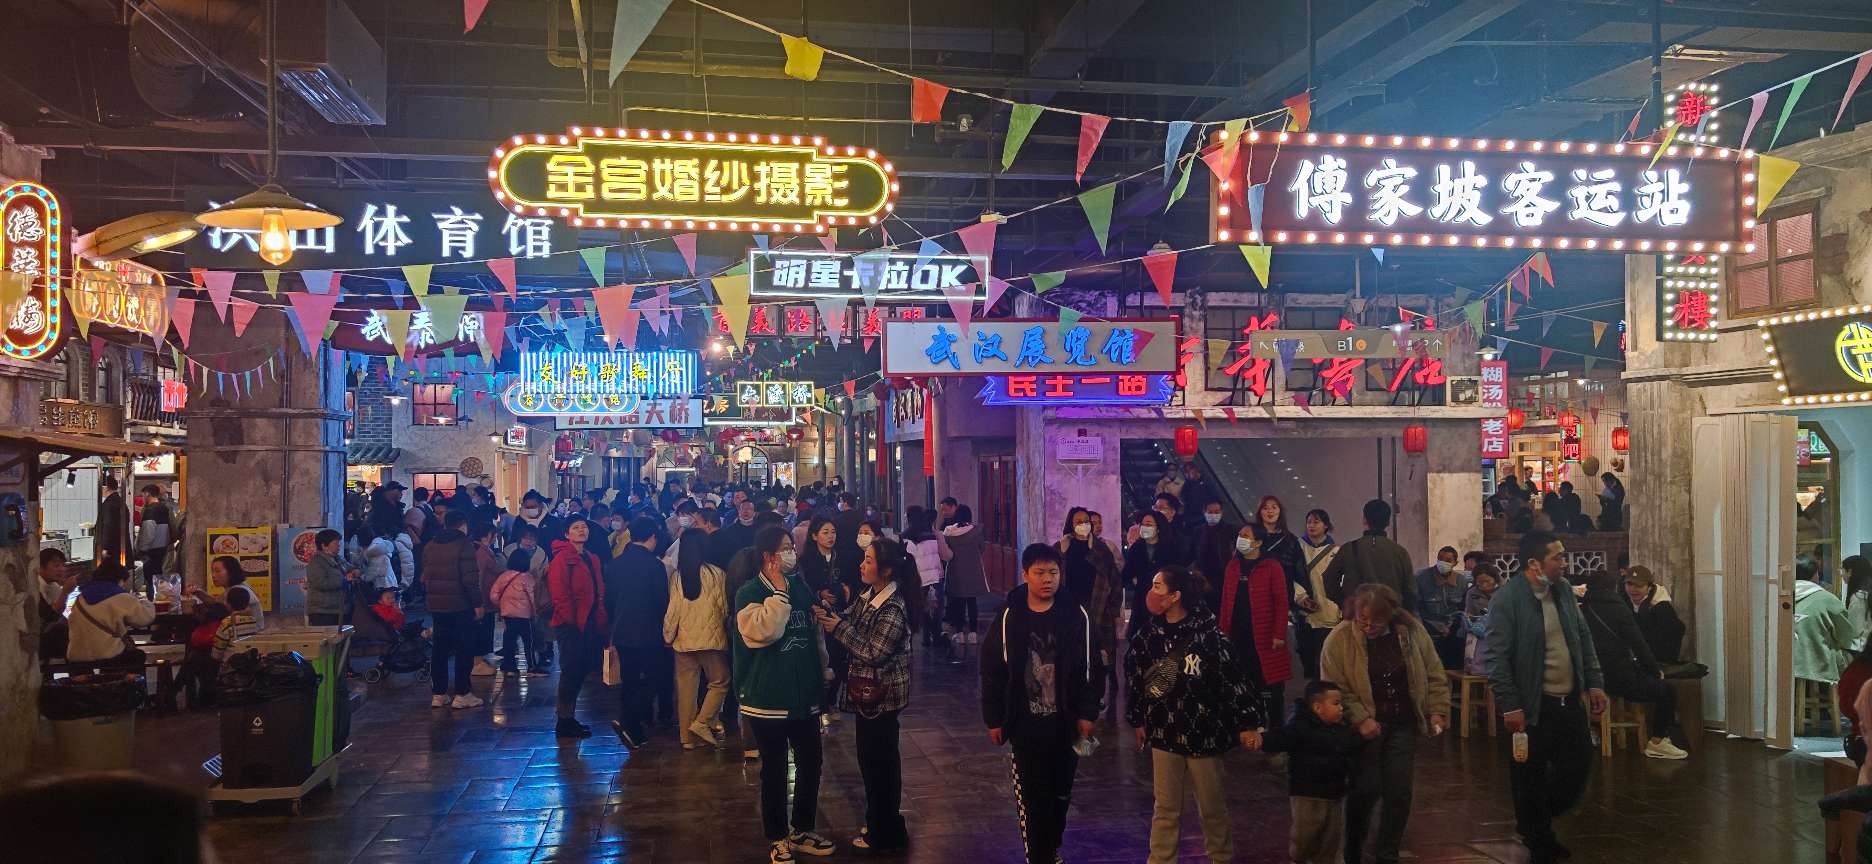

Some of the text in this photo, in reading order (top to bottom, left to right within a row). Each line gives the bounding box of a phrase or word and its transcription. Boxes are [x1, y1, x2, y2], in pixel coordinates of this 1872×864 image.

[546, 154, 849, 206] 金宫婚纱摄影
[1290, 154, 1691, 227] 傅家坡客运站
[773, 259, 968, 290] 明星卡拉OK
[924, 325, 1138, 369] 武汉展览馆
[1338, 336, 1353, 351] B1
